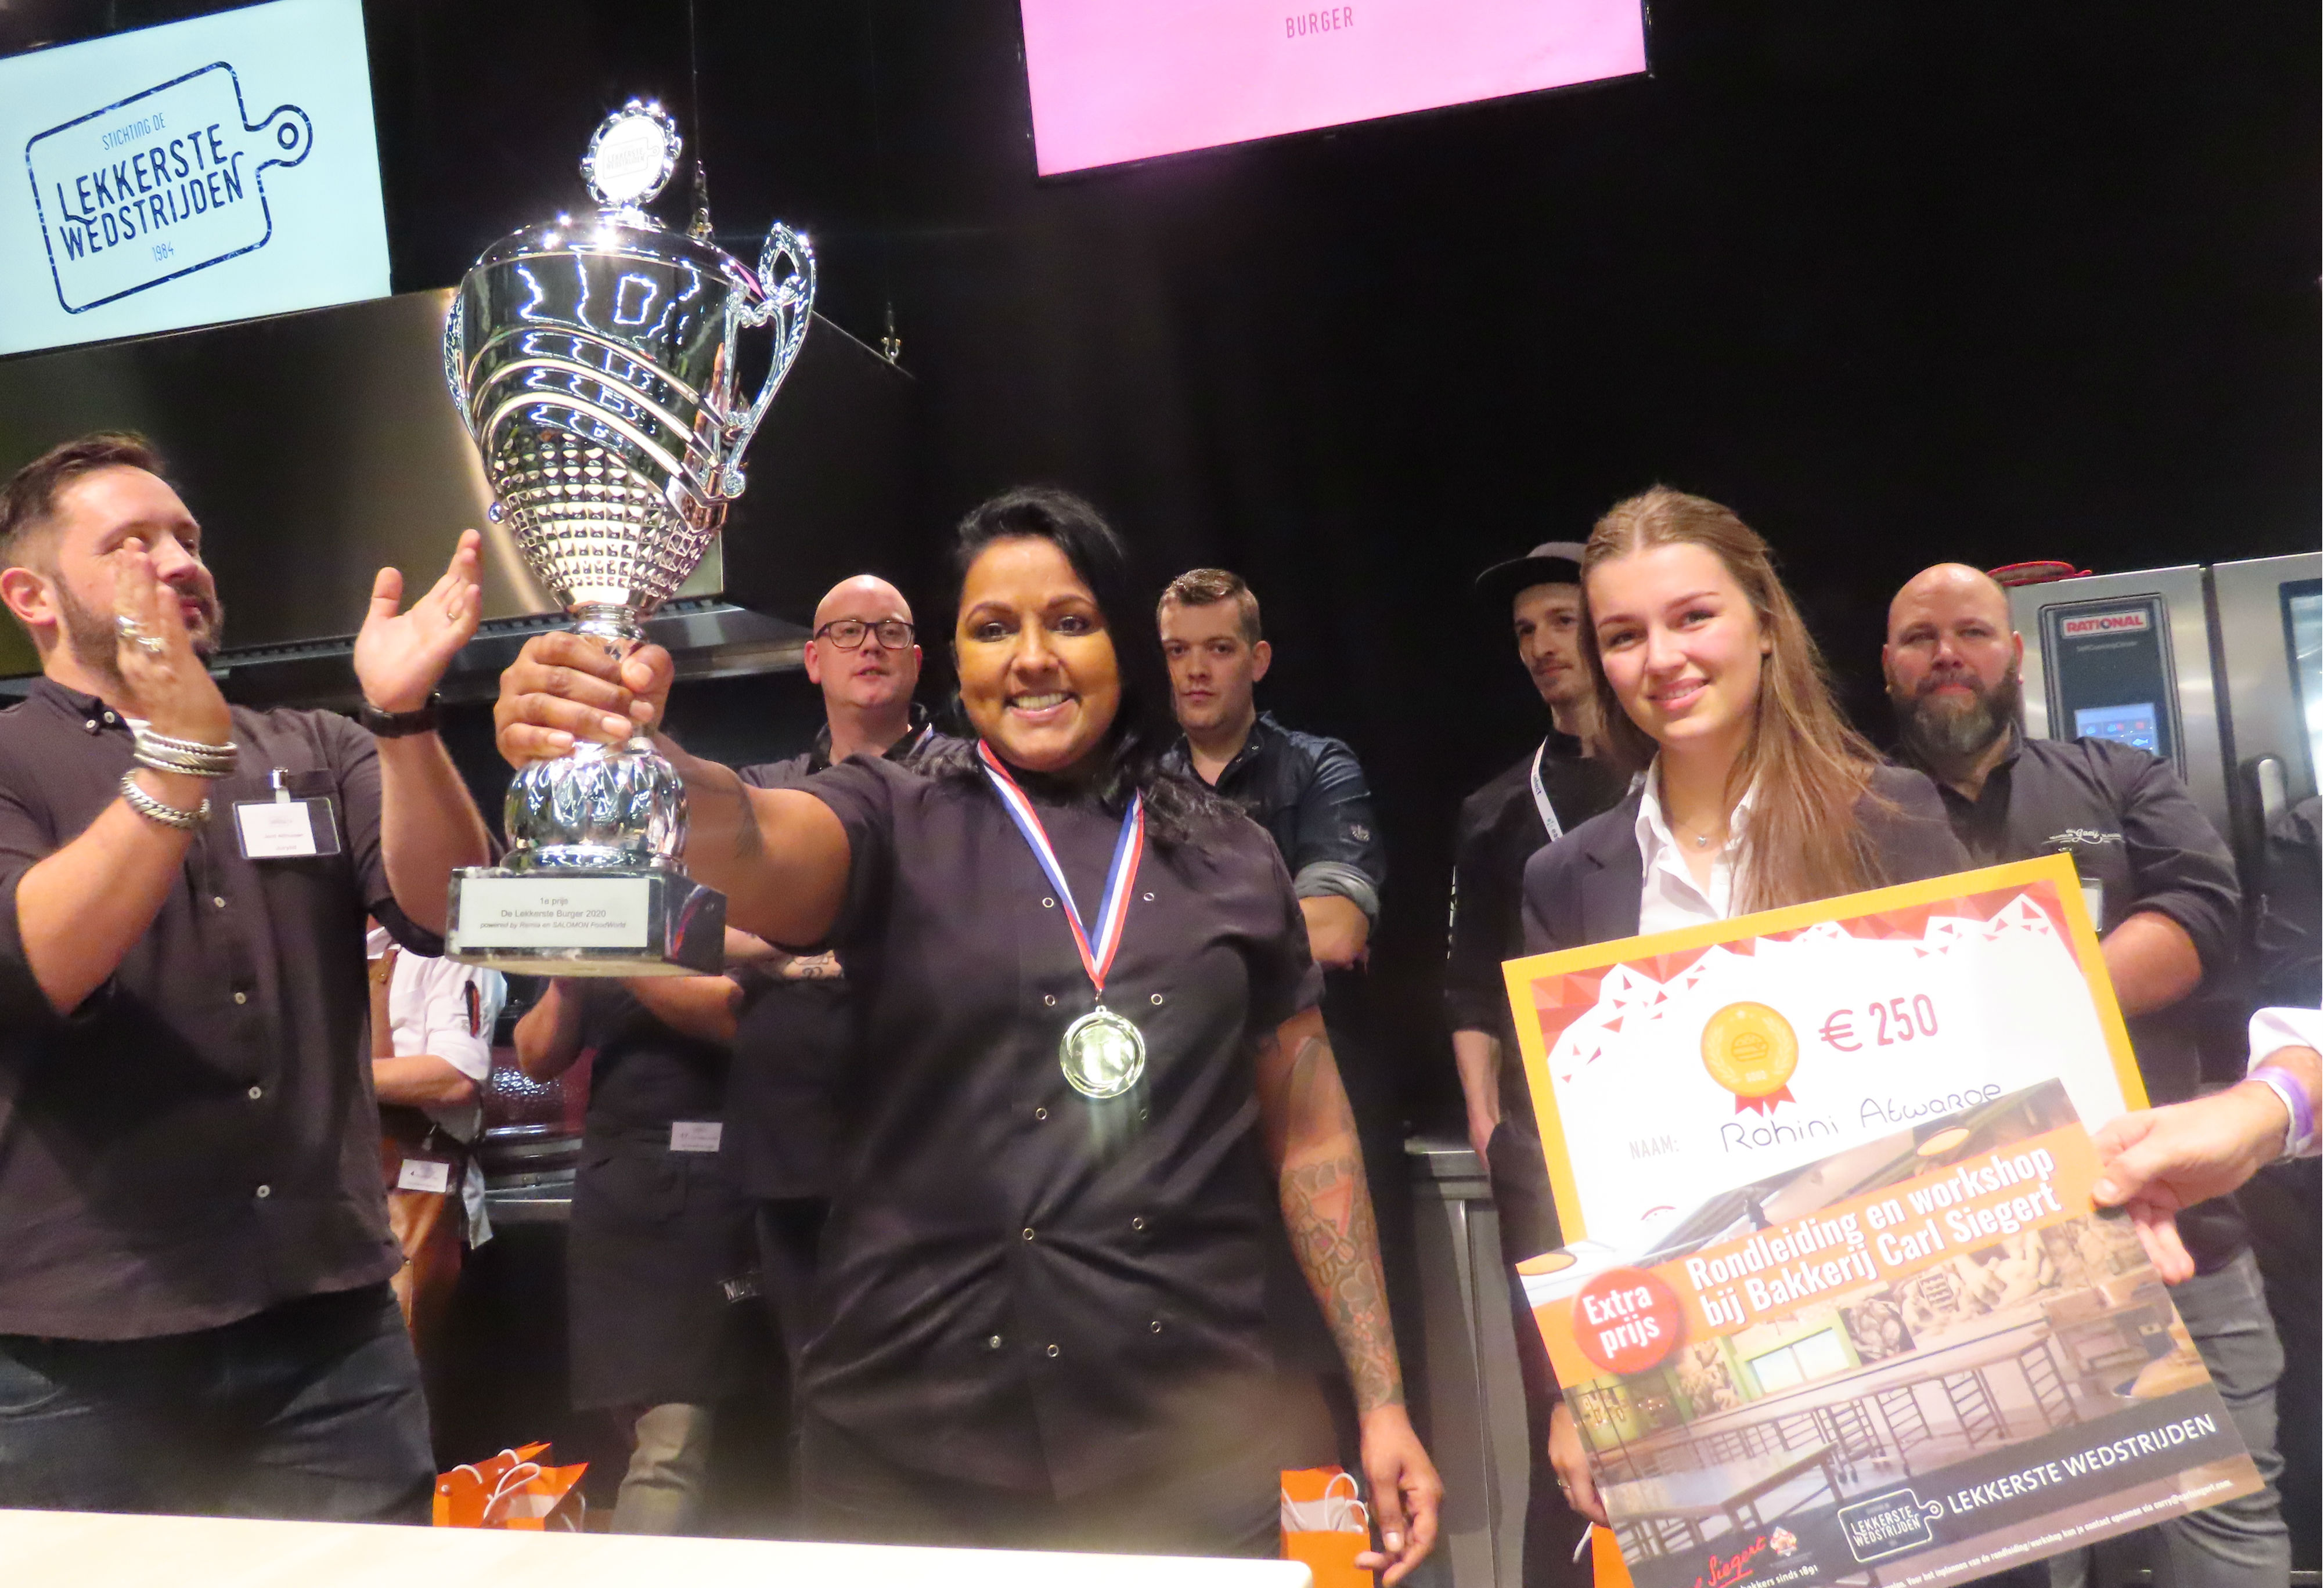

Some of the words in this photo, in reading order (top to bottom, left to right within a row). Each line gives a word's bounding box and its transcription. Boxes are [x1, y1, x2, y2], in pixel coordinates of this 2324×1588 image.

[1286, 7, 1353, 38] BURGER
[102, 118, 151, 150] STICHTING
[153, 113, 166, 131] DE
[57, 124, 228, 225] LEKKERSTE
[59, 151, 244, 261] WEDSTRIJDEN
[152, 241, 174, 262] 1984
[2066, 616, 2143, 633] RATIONAL
[501, 910, 513, 918] De
[515, 910, 554, 918] Lekkerste
[556, 910, 584, 919] Burger
[586, 910, 607, 918] 2020
[552, 897, 568, 906] prijs
[1818, 1009, 1863, 1052] €
[1869, 994, 1938, 1046] 250
[1629, 1134, 1680, 1160] NAAM:
[1720, 1116, 1838, 1152] Rohini
[1686, 1211, 1865, 1291] Rondleiding
[1866, 1199, 1907, 1230] en
[1908, 1148, 2055, 1215] workshop
[1699, 1289, 1746, 1326] bij
[1745, 1243, 1878, 1312] Bakkerij
[1876, 1219, 1945, 1266] Carl
[1944, 1182, 2062, 1243] Siegert
[1583, 1285, 1653, 1326] Extra
[1599, 1313, 1660, 1359] prijs
[1947, 1462, 2062, 1514] LEKKERSTE
[2061, 1413, 2217, 1477] WEDSTRIJDEN
[1850, 1506, 1914, 1537] LEKKERSTE
[1853, 1513, 1921, 1547] WEDSTRIJDEN
[1708, 1535, 1767, 1587] Siegert
[1905, 1576, 1922, 1586] Voor
[1922, 1571, 1936, 1580] het
[1934, 1562, 1968, 1578] inplannen
[1968, 1557, 1981, 1567] van
[1981, 1554, 1991, 1562] de
[1991, 1532, 2063, 1560] rondleiding/workshop
[2062, 1528, 2077, 1538] kun
[2076, 1525, 2085, 1535] je
[2084, 1516, 2112, 1531] contact
[2111, 1507, 2143, 1523] opnemen
[2142, 1503, 2154, 1513] via
[1776, 1569, 1799, 1584] sinds
[1799, 1564, 1819, 1577] 1891
